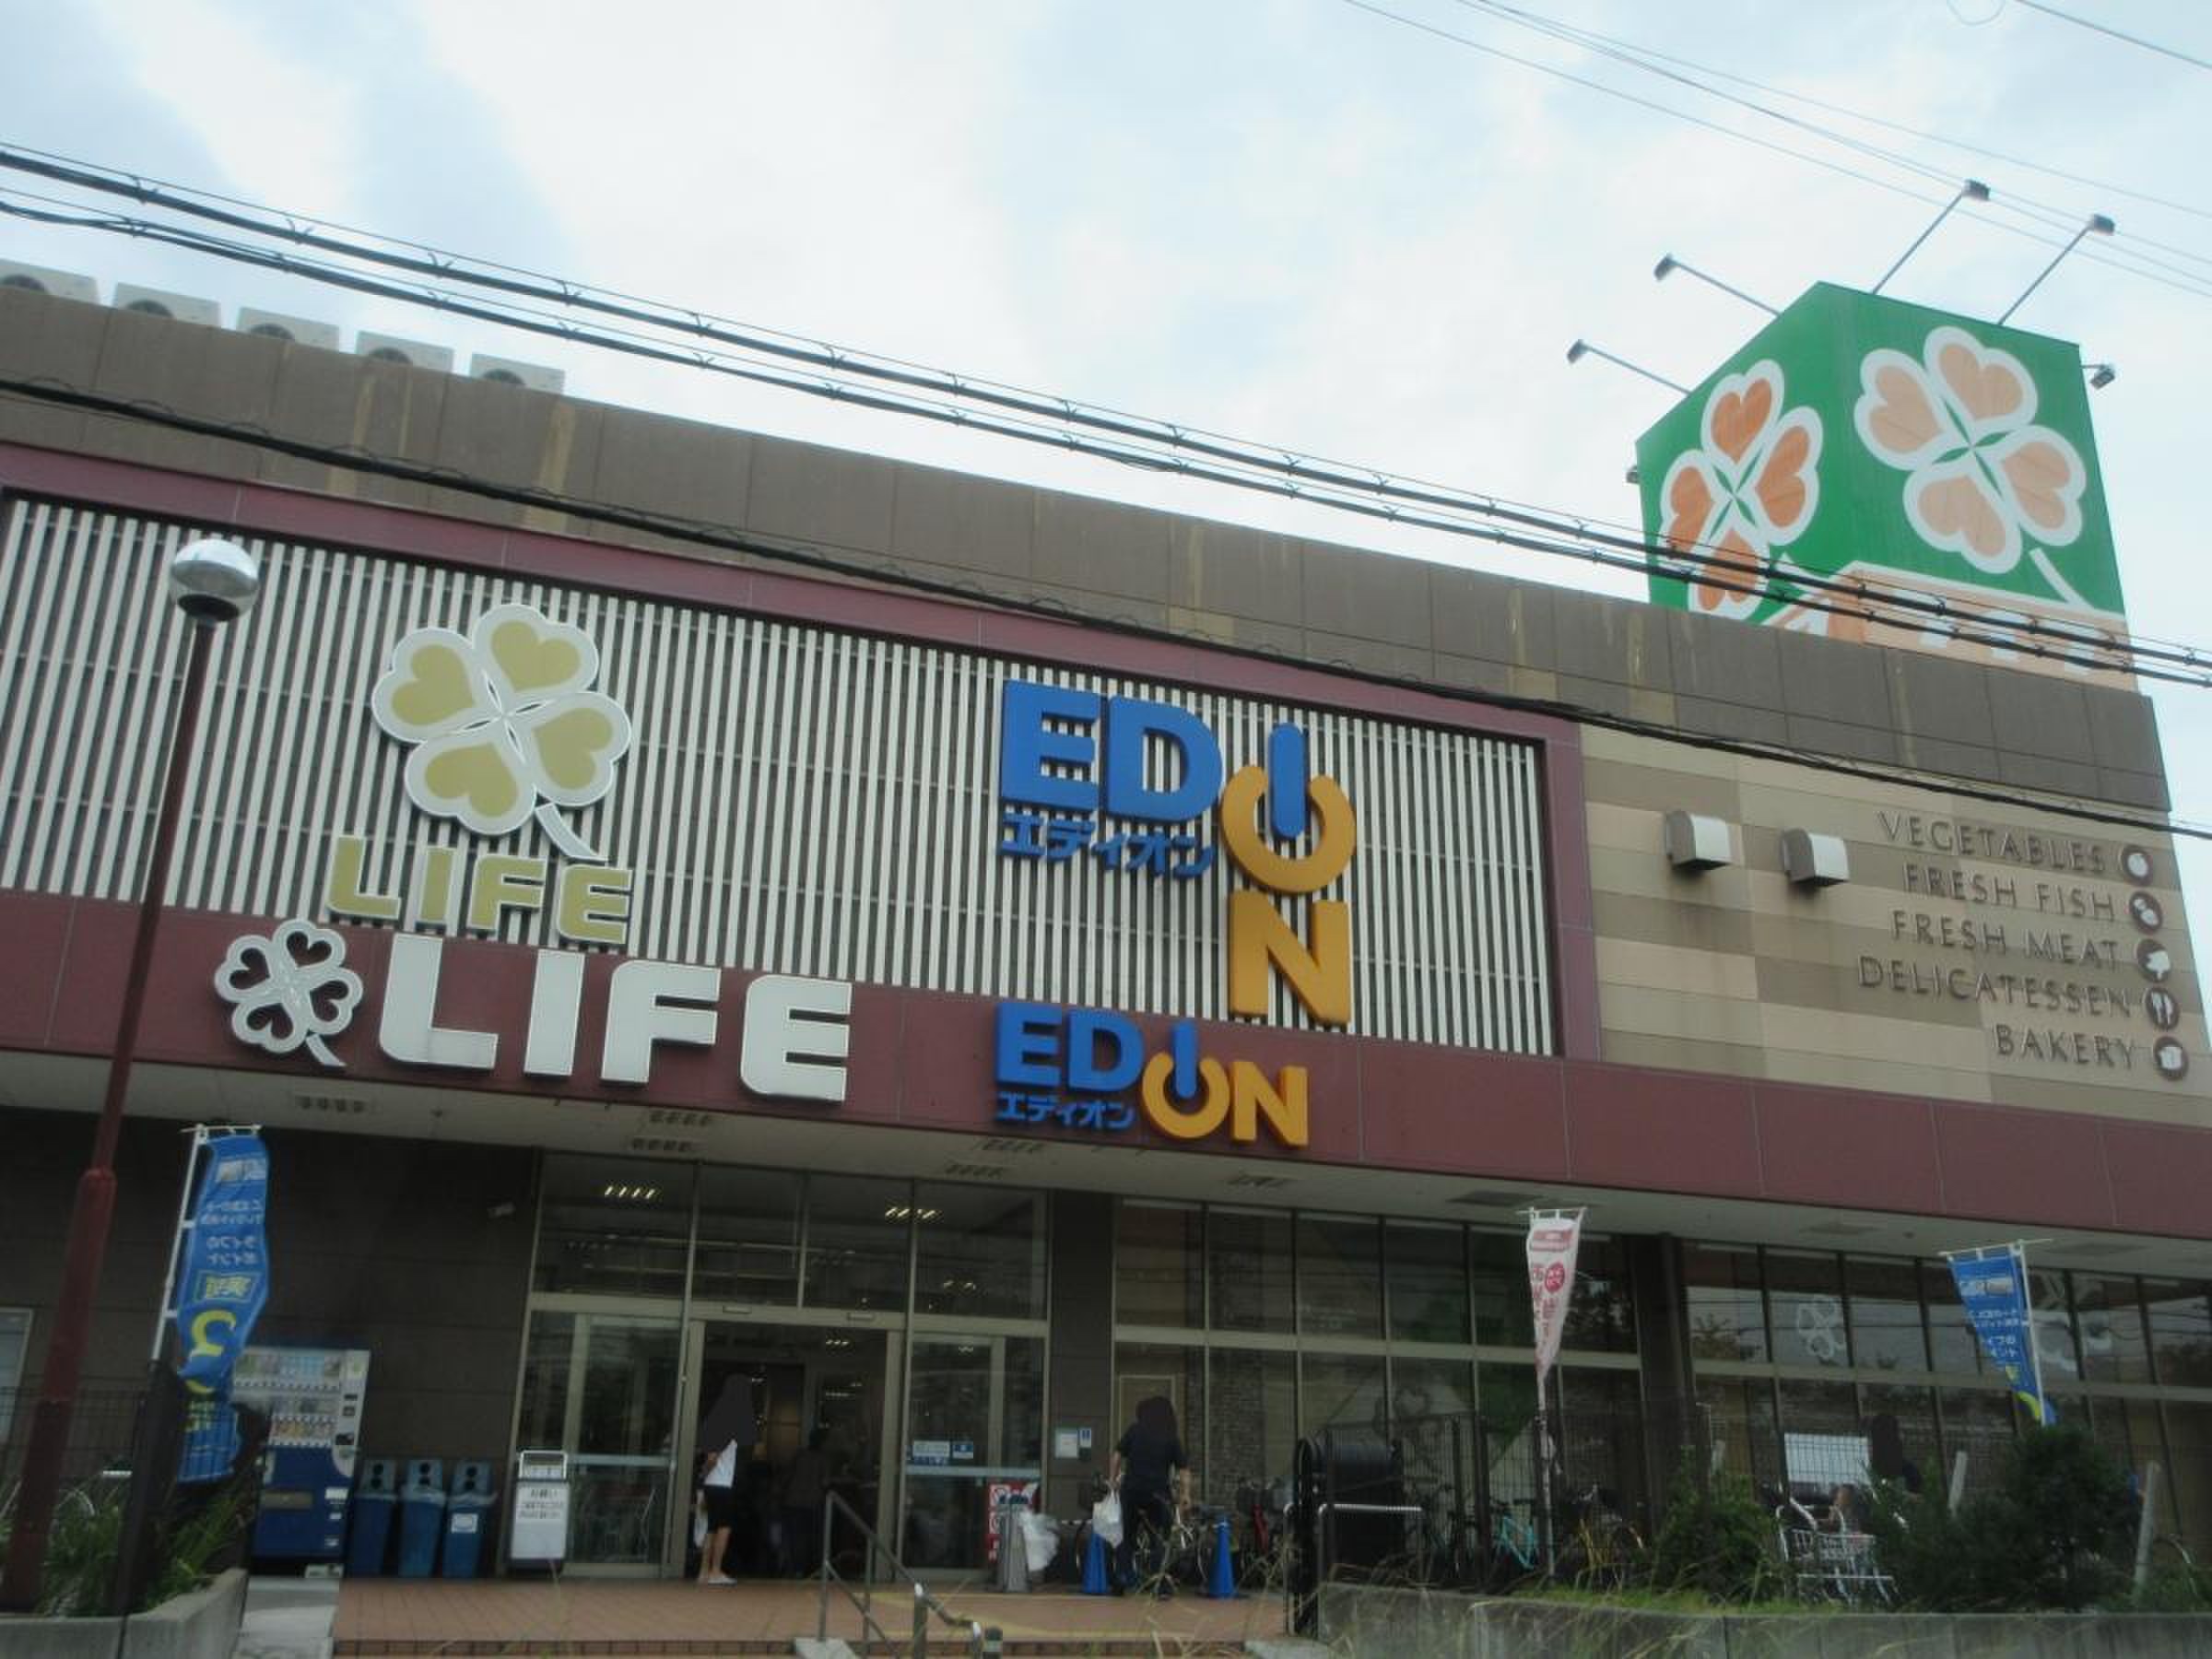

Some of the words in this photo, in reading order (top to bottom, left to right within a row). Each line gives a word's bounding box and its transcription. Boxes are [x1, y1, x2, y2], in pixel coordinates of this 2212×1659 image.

[1000, 810, 1216, 878] エディオン
[1002, 678, 1357, 1024] EDION
[1877, 809, 2109, 876] VEGETABLES
[324, 833, 633, 945] LIFE
[1902, 861, 2018, 911] FRESH
[2034, 881, 2116, 924] FISH
[1890, 908, 2007, 957] FRESH
[2027, 930, 2119, 971] MEAT
[378, 932, 854, 1103] LIFE
[1857, 954, 2132, 1019] DELICATESSEN
[995, 1001, 1308, 1147] EDION
[1993, 1023, 2137, 1071] BAKERY
[995, 1090, 1136, 1131] エディオン
